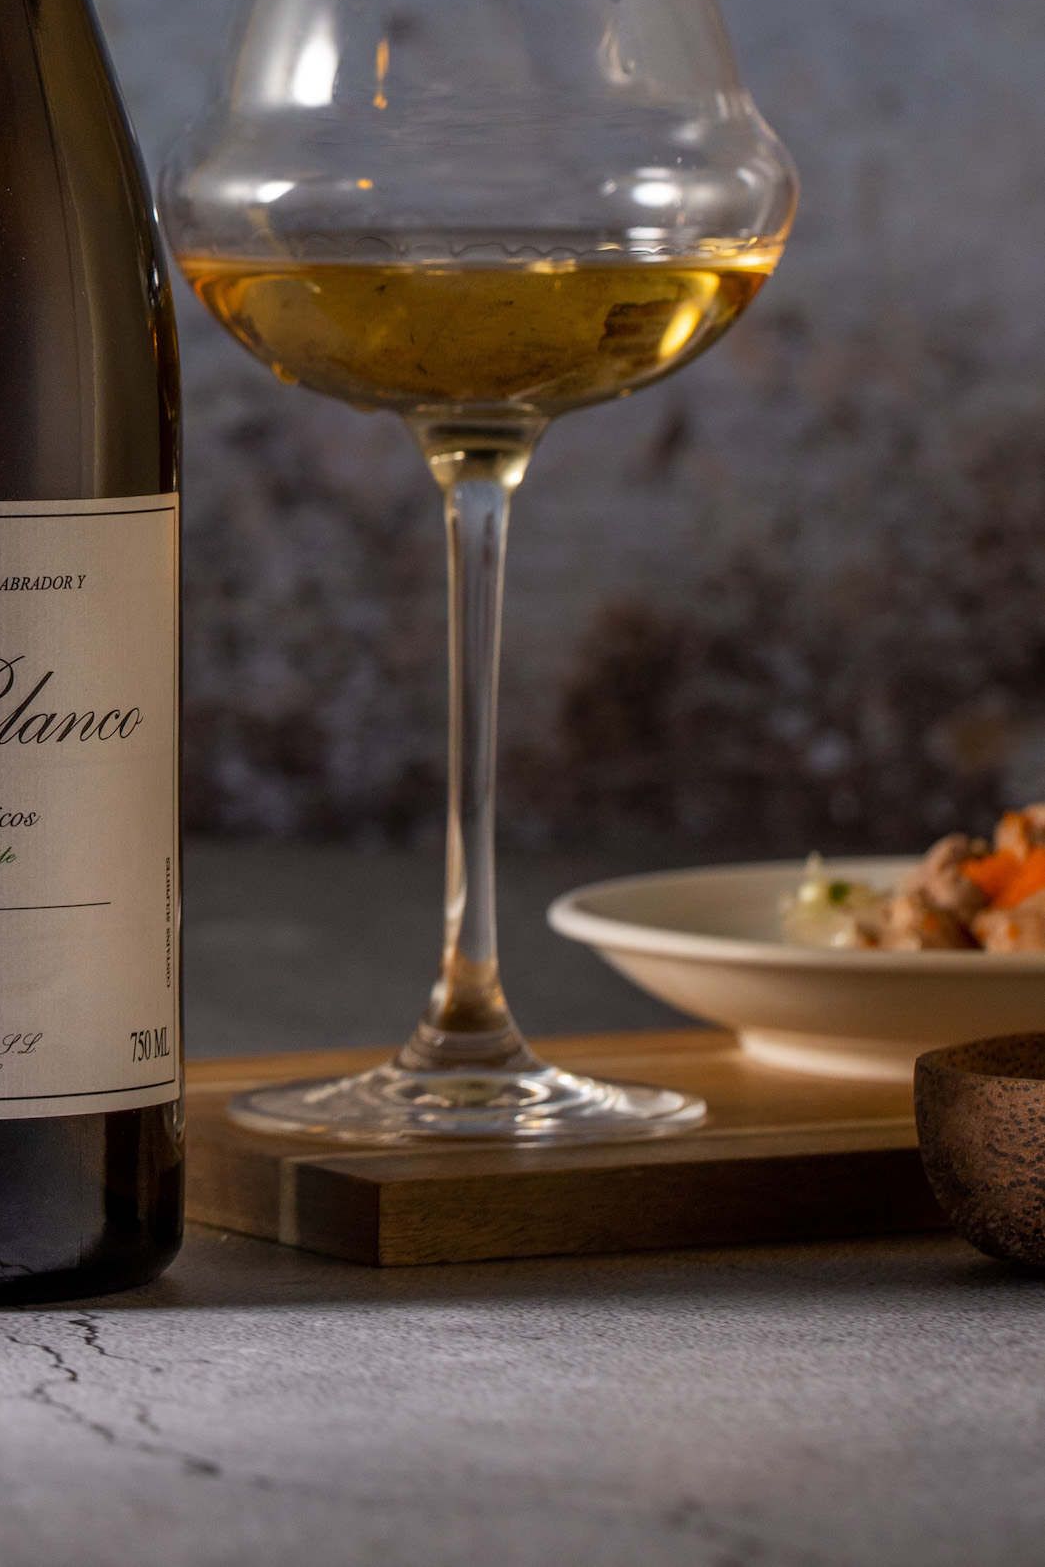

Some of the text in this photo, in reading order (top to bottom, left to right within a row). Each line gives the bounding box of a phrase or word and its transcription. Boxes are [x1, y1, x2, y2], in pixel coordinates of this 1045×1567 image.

[75, 574, 87, 589] Y
[130, 1026, 170, 1062] 750 ML
